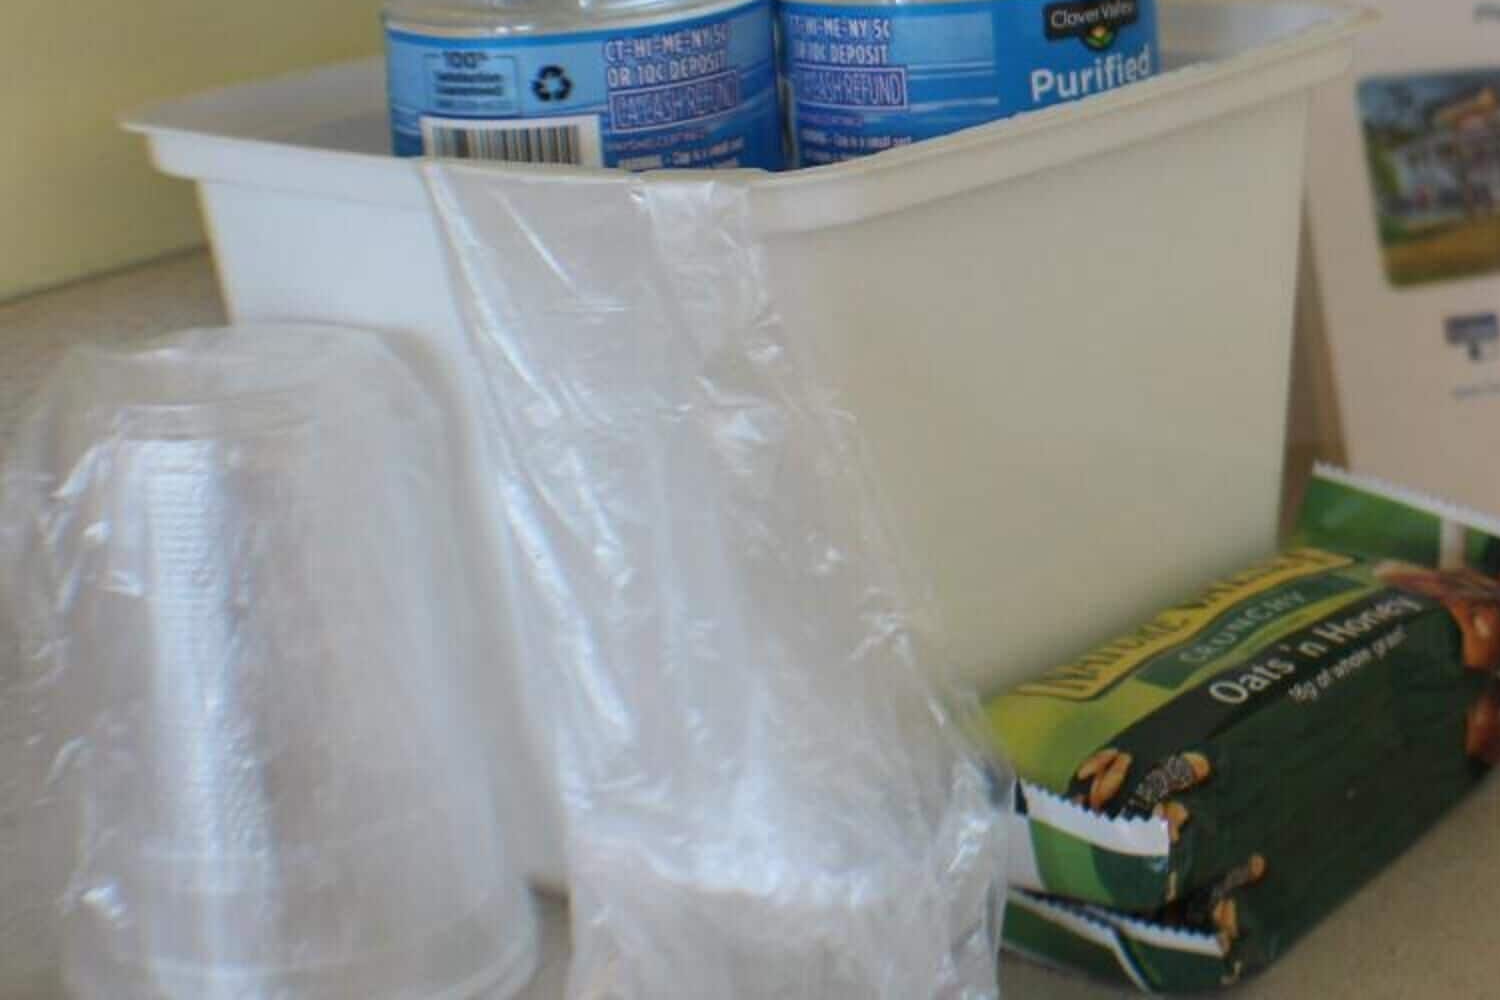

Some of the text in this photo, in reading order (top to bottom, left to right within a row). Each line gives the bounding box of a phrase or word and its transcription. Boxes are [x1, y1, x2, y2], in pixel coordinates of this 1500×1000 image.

[1050, 7, 1099, 28] Clover
[831, 44, 887, 65] DEPOSIT
[608, 65, 632, 88] OR
[1031, 44, 1151, 101] Purified
[1208, 656, 1296, 705] Oats
[1312, 595, 1424, 644] Honey
